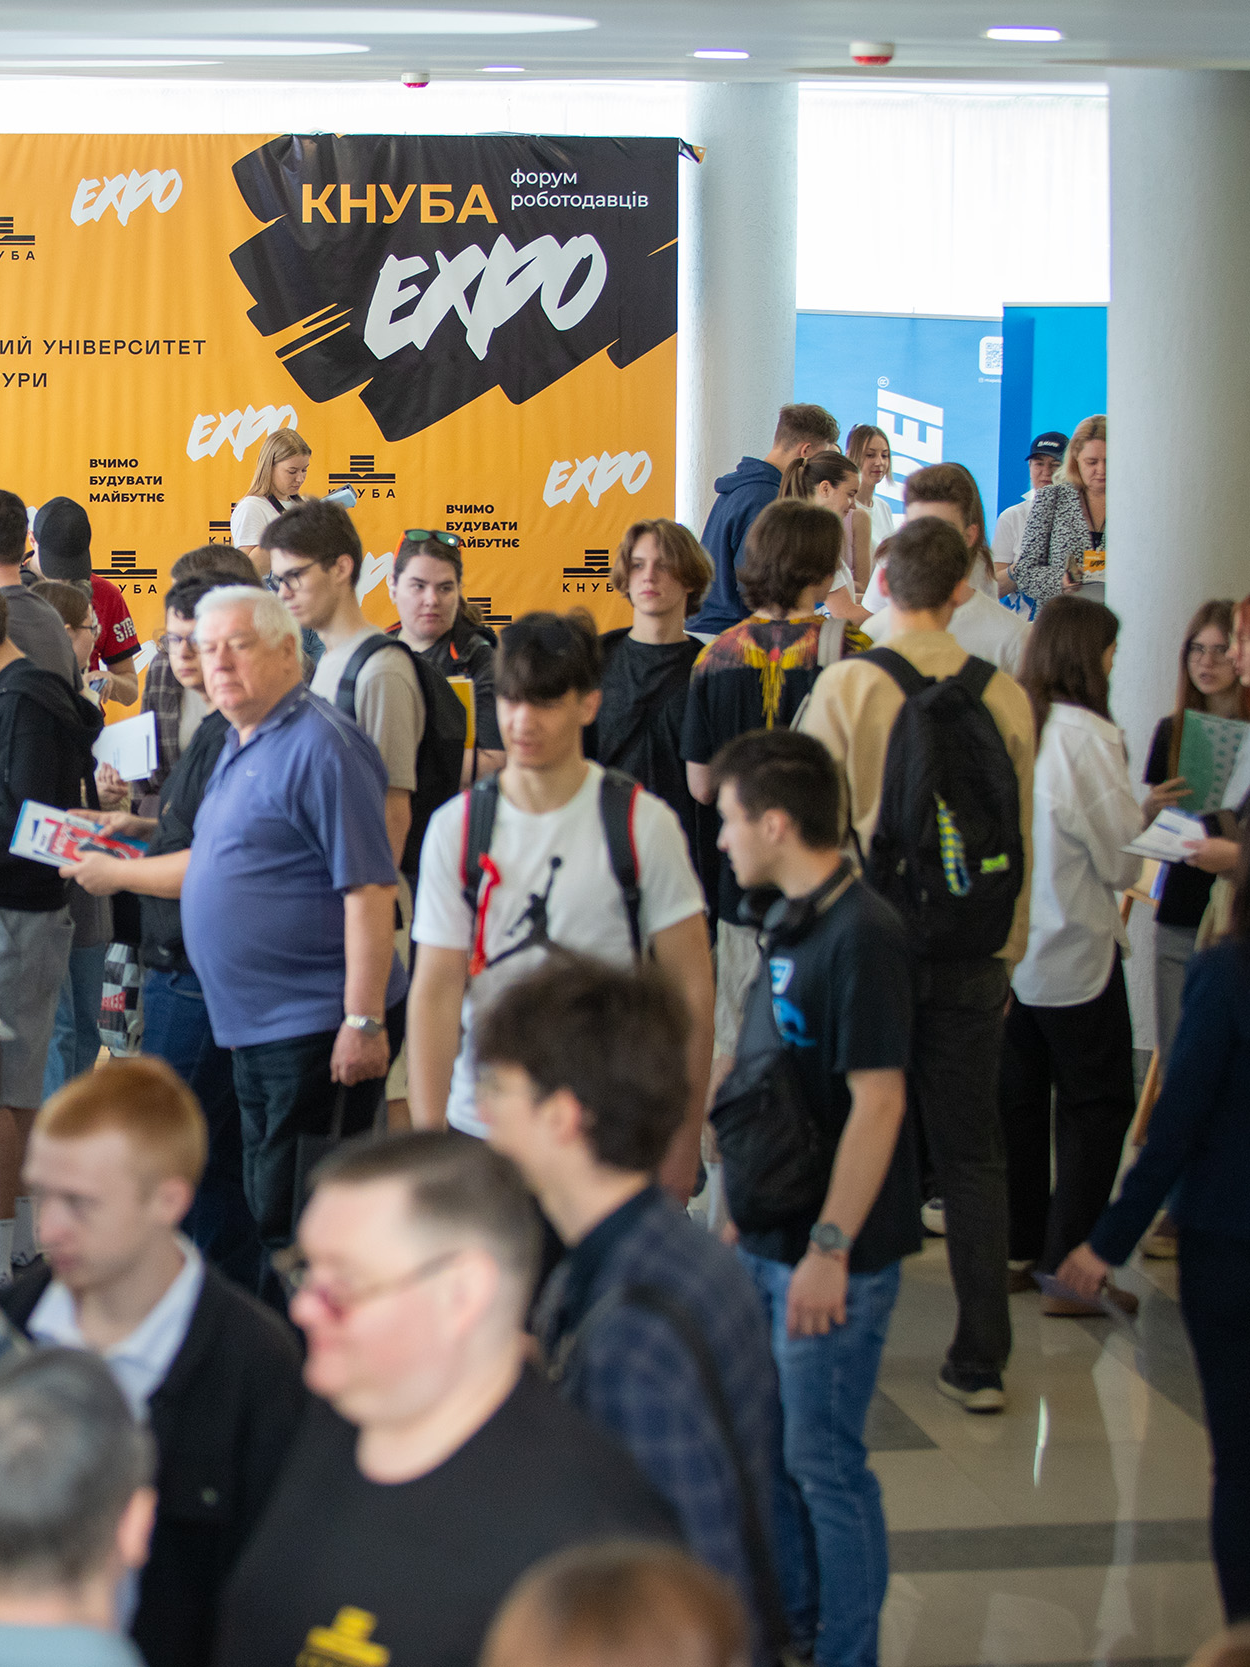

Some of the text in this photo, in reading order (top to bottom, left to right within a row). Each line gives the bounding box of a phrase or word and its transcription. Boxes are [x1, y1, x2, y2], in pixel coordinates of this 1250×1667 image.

[510, 168, 577, 187] форум
[70, 169, 183, 226] EXPO
[301, 184, 499, 224] КНУБА
[510, 190, 649, 210] роботодавців
[364, 234, 607, 360] EXPO
[43, 339, 207, 355] УНІВЕРСИТЕТ
[186, 404, 299, 462] EXPO
[89, 458, 139, 468] ВЧИМО
[89, 475, 164, 487] БУДУВАТИ
[543, 451, 653, 507] EXPO
[89, 490, 165, 503] МАЙБУТНЄ
[446, 504, 495, 514] ВЧИМО
[446, 521, 519, 533] БУДУВАТИ
[457, 536, 521, 549] АЙБУТНЄ
[562, 582, 614, 593] КНУБ
